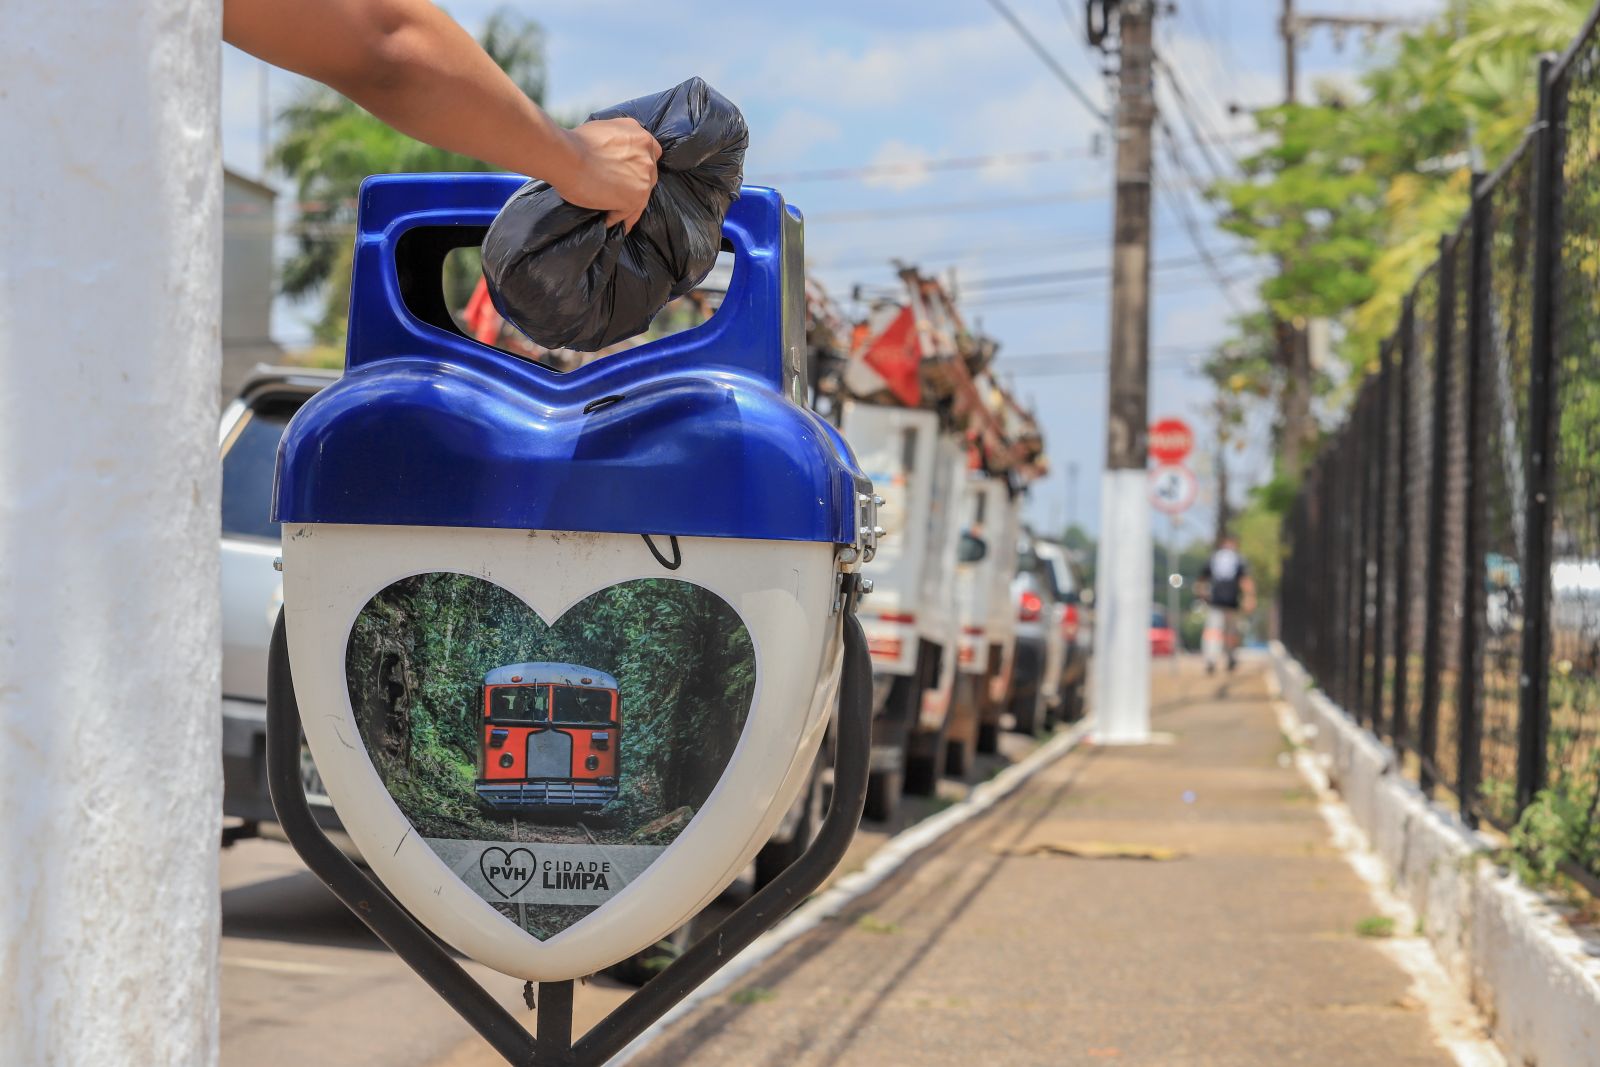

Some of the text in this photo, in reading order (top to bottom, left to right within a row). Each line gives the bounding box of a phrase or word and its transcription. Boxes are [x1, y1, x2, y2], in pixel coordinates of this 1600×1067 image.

[490, 866, 526, 880] PVH
[543, 861, 610, 872] CIDADE
[543, 872, 609, 890] LIMPA
